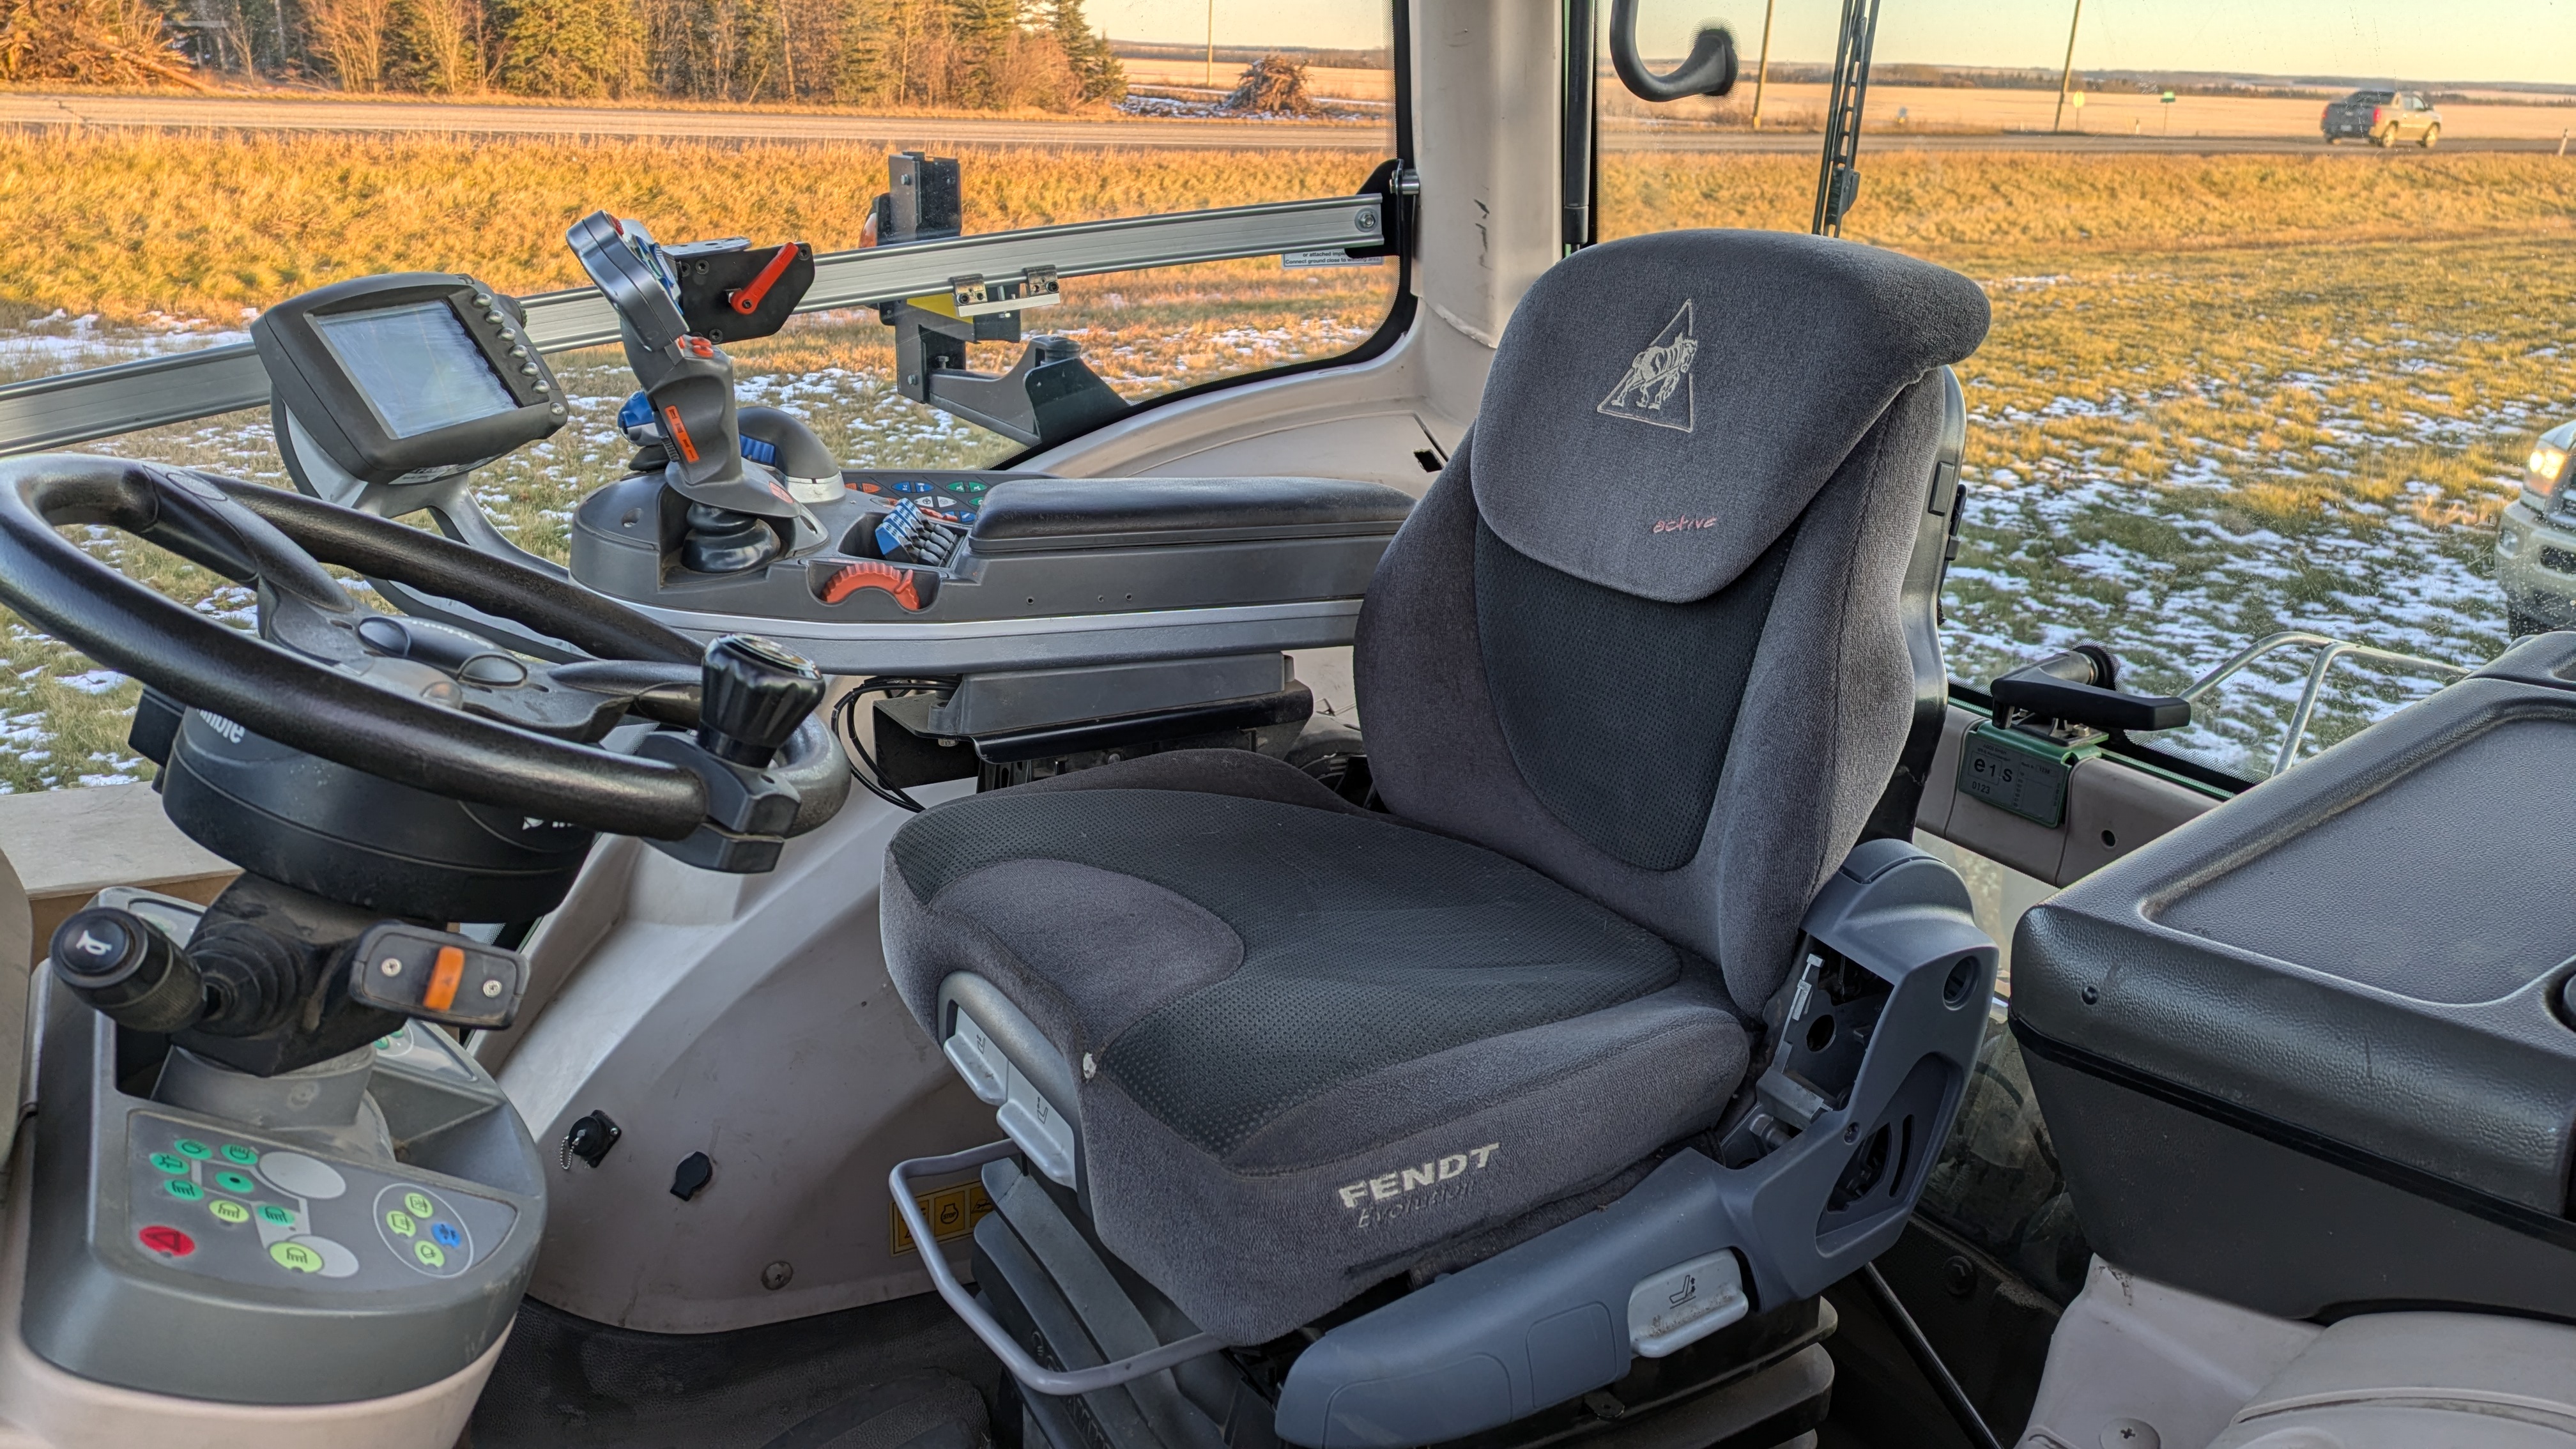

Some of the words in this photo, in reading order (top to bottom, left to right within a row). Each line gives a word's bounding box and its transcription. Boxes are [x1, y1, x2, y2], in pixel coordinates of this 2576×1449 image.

[1653, 514, 1717, 533] active
[1972, 781, 1991, 794] 0123
[1338, 1142, 1500, 1208] FENDT
